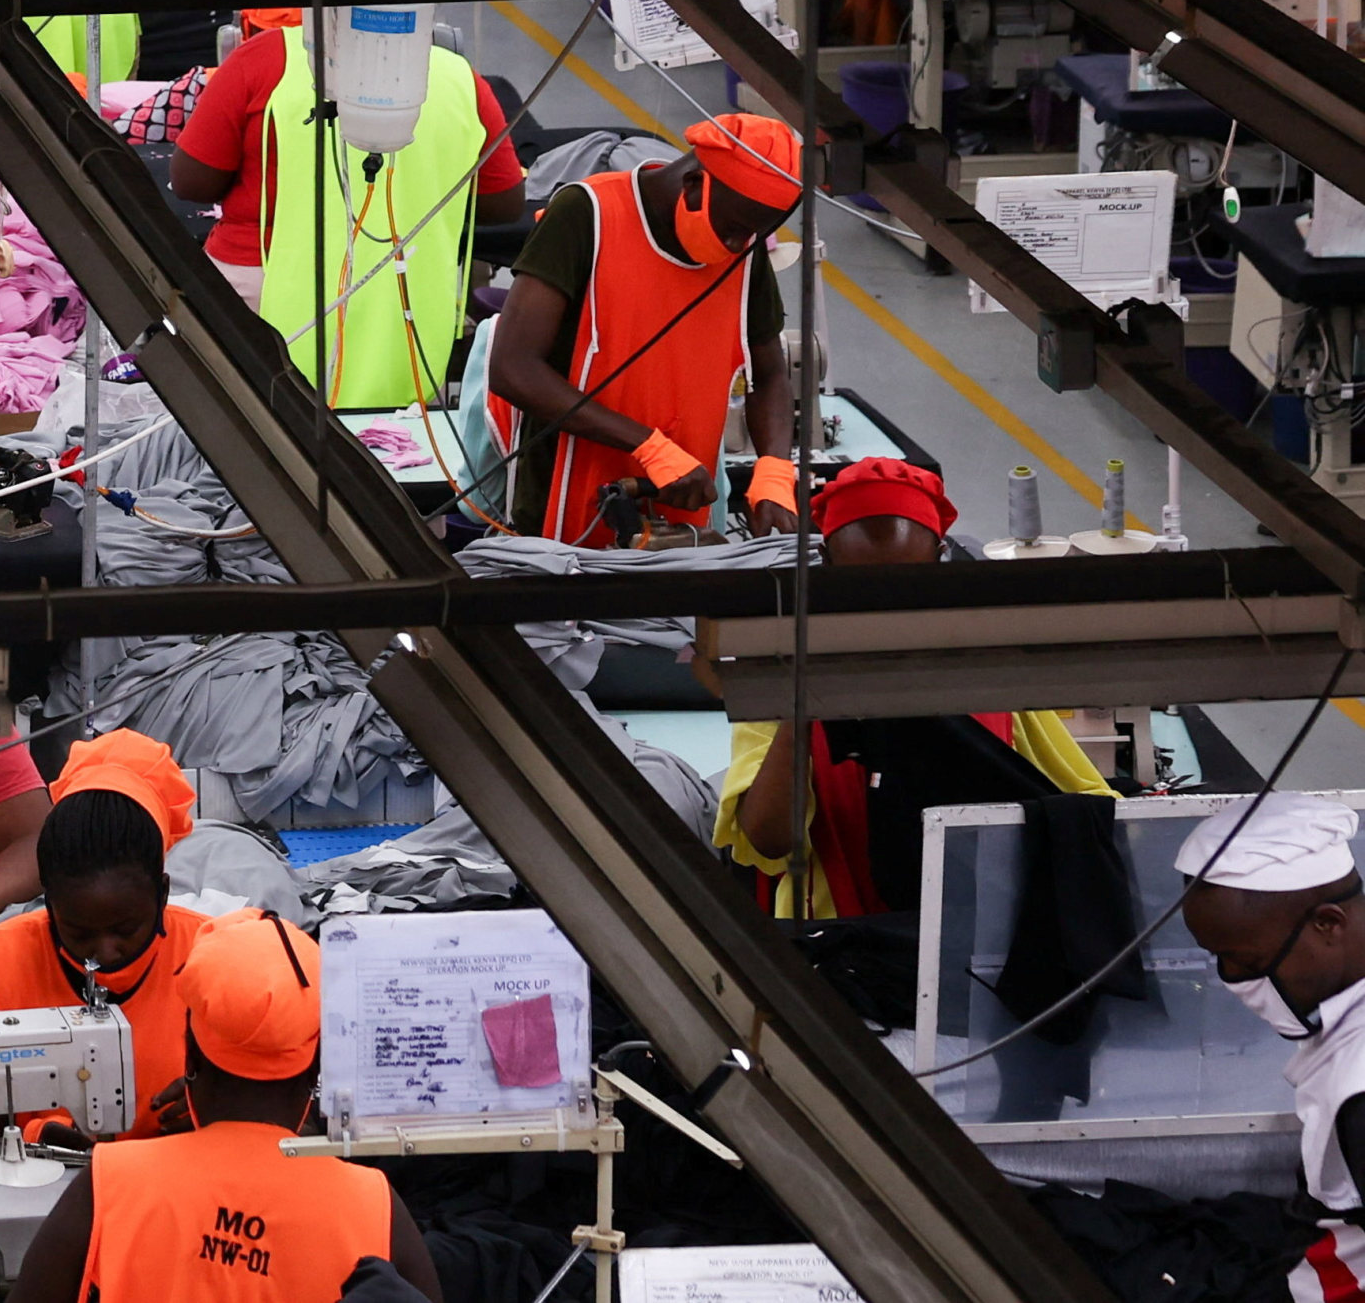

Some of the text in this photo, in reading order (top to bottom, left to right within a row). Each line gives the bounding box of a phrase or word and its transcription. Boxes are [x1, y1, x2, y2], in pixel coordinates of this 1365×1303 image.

[471, 965, 493, 973] MOCK
[495, 964, 506, 972] UP
[494, 979, 551, 992] MOCK UP
[215, 1206, 266, 1240] MO
[199, 1234, 271, 1277] NW-01
[774, 1271, 801, 1280] MOCK
